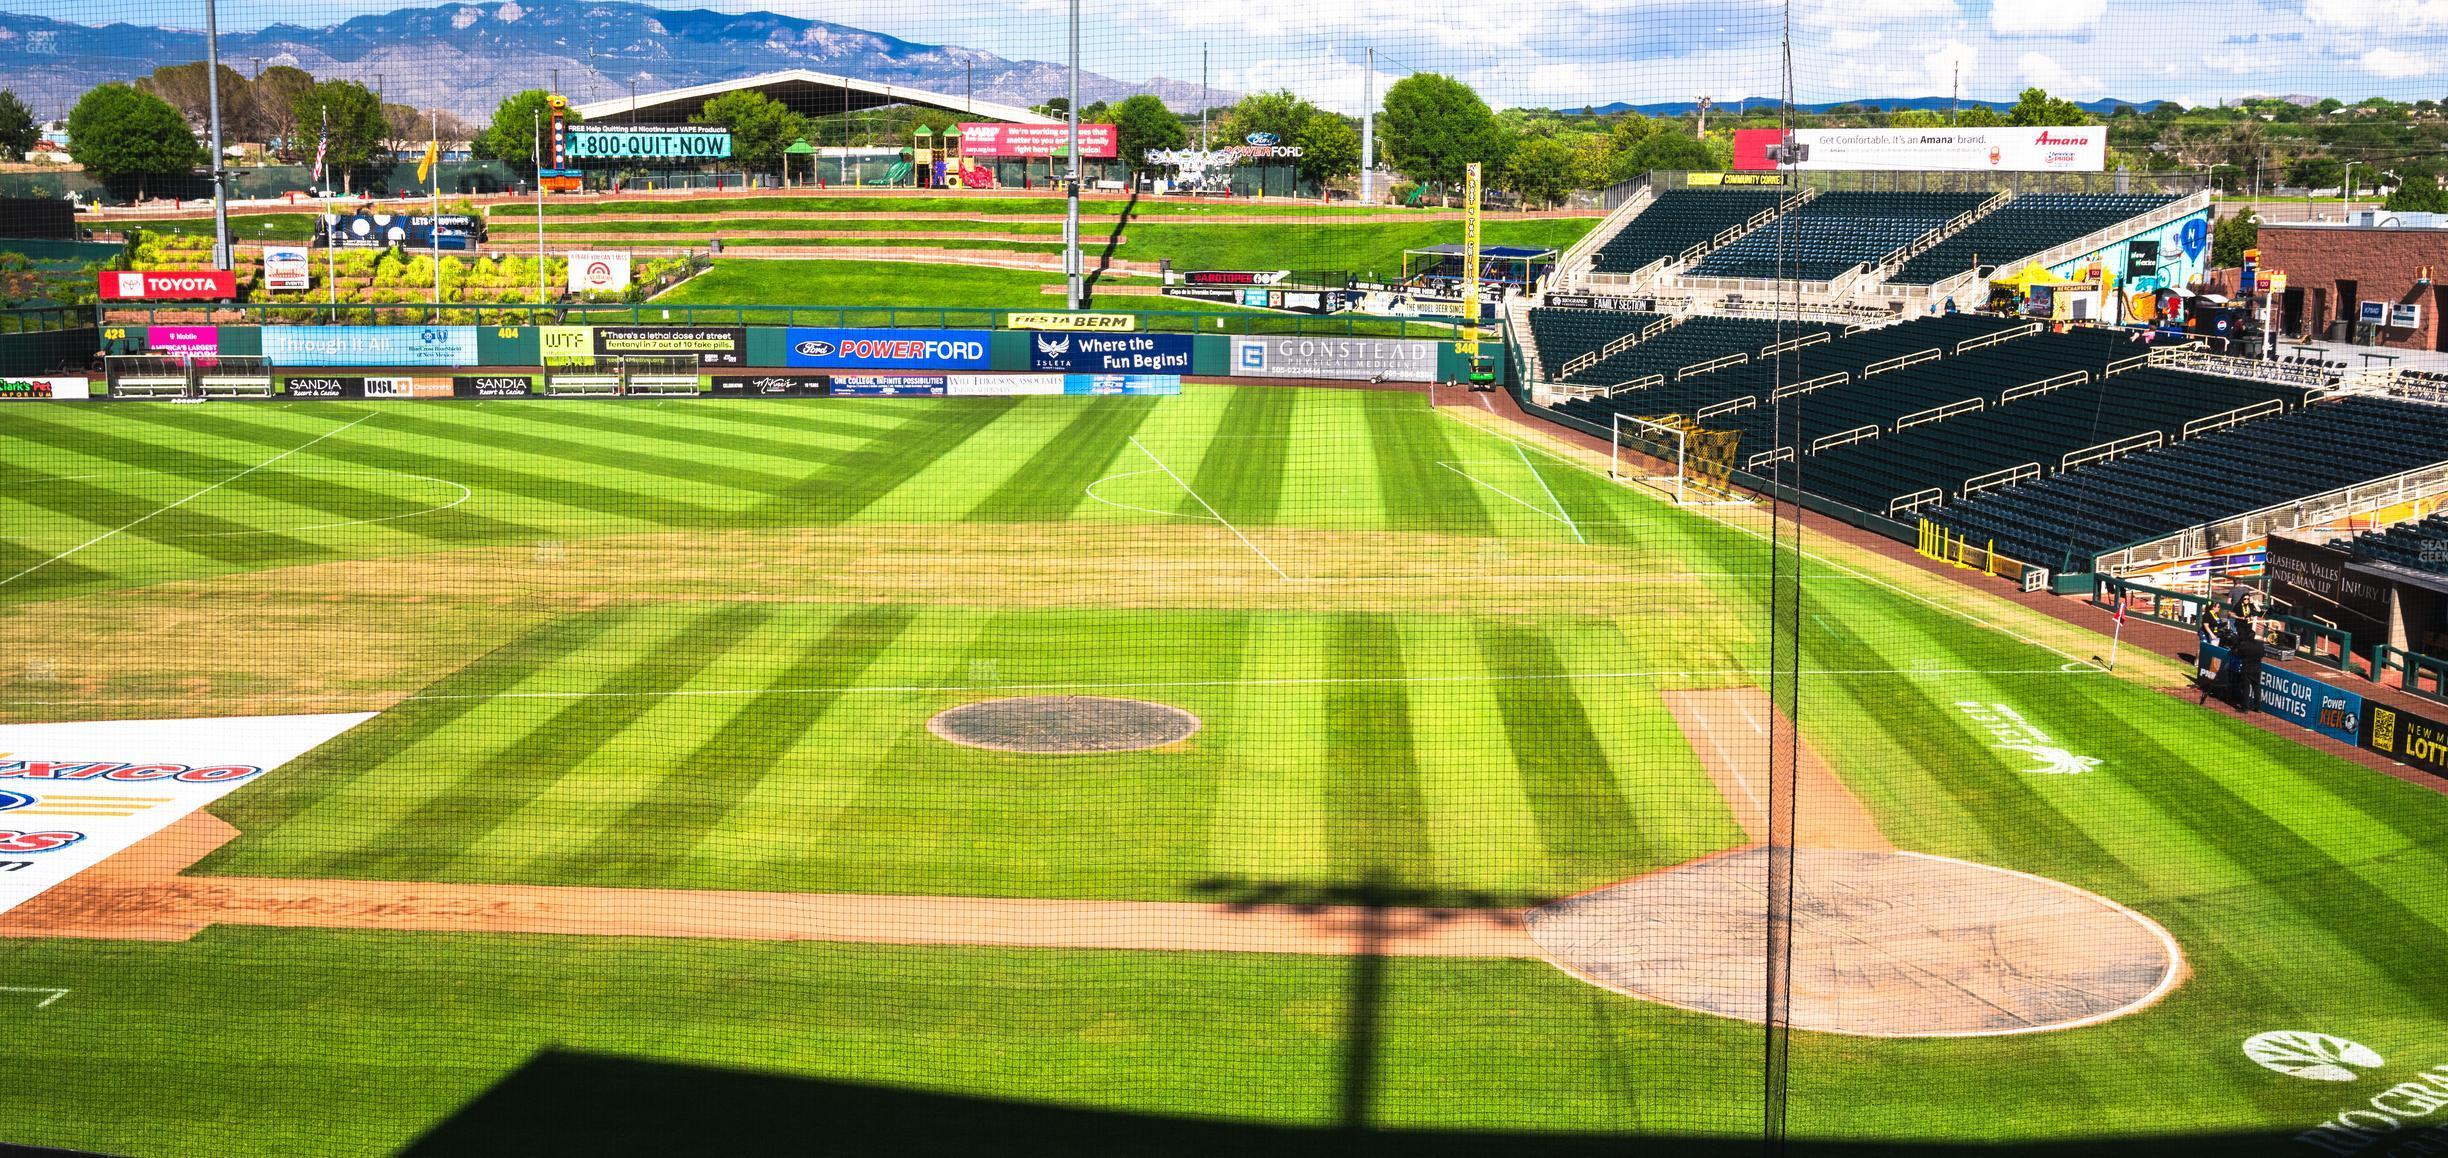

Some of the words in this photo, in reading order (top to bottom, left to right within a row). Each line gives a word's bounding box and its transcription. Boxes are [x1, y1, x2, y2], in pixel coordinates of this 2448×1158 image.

[586, 125, 601, 133] Help
[602, 125, 629, 133] Quitting
[966, 127, 1001, 137] AARP
[1030, 128, 1059, 136] working
[1007, 136, 1031, 144] matter
[1032, 136, 1040, 144] to
[1041, 137, 1054, 145] you
[1087, 136, 1109, 146] family
[1819, 135, 1834, 145] Get
[1836, 135, 1891, 145] Comfortable.
[1892, 135, 1906, 144] It's
[1920, 136, 1953, 144] Amana
[1957, 135, 1987, 144] brand.
[2035, 130, 2089, 145] Amana
[1015, 145, 1031, 154] right
[1724, 174, 1760, 184] COMMUNITY
[412, 217, 428, 226] LETS
[148, 278, 217, 291] TOYOTA
[1406, 303, 1416, 311] THE
[1435, 304, 1448, 313] BEER
[1449, 305, 1464, 313] SINCE
[1594, 298, 1618, 309] FAMILY
[1619, 300, 1647, 310] SECTION
[1014, 315, 1070, 323] FIESTA
[1073, 317, 1128, 327] BERM
[104, 329, 126, 339] 428
[498, 328, 519, 339] 404
[608, 331, 639, 340] There's
[647, 331, 671, 340] lethal
[672, 331, 694, 340] dose
[695, 331, 705, 340] of
[706, 331, 731, 340] street
[279, 336, 349, 355] Through
[351, 336, 364, 351] It
[546, 334, 583, 348] WTF
[608, 341, 642, 350] fentanyl
[713, 341, 732, 350] pills.
[1078, 338, 1127, 353] Where
[1129, 337, 1154, 350] the
[802, 342, 828, 355] Ford
[838, 340, 984, 360] POWERFORD
[1279, 340, 1426, 360] GONSTEAD
[1454, 342, 1474, 354] 340
[1103, 355, 1130, 369] Fun
[1134, 352, 1188, 369] Begins!
[1287, 358, 1351, 367] PHYSICAL
[1356, 360, 1417, 369] MEDICINE
[33, 380, 51, 391] Pet
[290, 379, 342, 390] SANDIA
[475, 378, 527, 389] SANDIA
[834, 377, 847, 385] ONE
[848, 377, 876, 386] COLLEGE,
[877, 377, 902, 385] INFINITE
[903, 377, 944, 385] POSSIBILITIES
[949, 377, 970, 385] WILL
[2266, 551, 2309, 574] GLASHEEN,
[2310, 561, 2339, 581] VALLES
[2318, 581, 2331, 593] LLP
[2341, 577, 2379, 601] INJURY
[2260, 671, 2289, 693] ERING
[2291, 683, 2312, 701] OUR
[2260, 688, 2307, 718] MUNITIES
[2321, 695, 2347, 710] Power
[2319, 708, 2343, 728] KICK
[2407, 722, 2432, 739] NEW
[2406, 734, 2448, 767] LOTT
